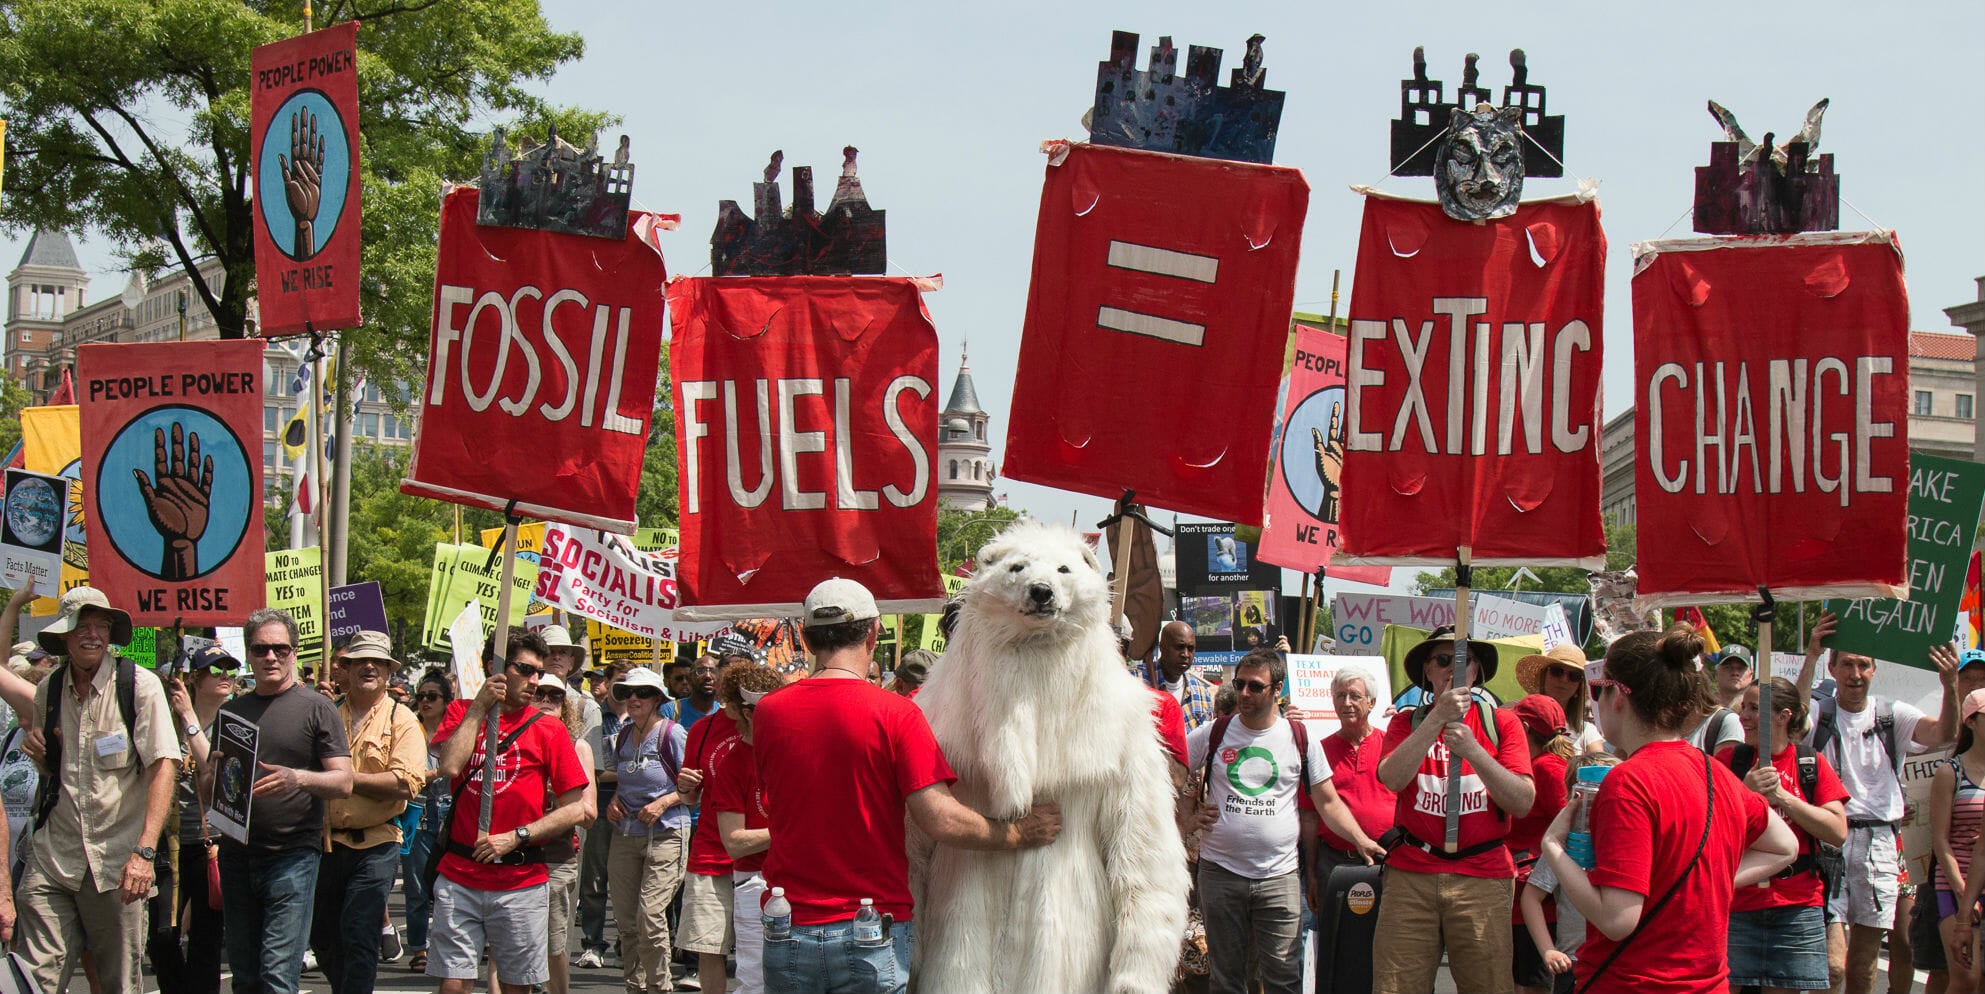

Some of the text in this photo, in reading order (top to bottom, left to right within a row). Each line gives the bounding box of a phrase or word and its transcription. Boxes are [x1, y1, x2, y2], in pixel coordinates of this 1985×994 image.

[258, 49, 352, 92] PEOPLE POWER
[281, 265, 333, 293] WE RISE
[429, 284, 644, 436] FOSSIL
[1294, 349, 1343, 378] PEOPL
[89, 372, 255, 402] PEOPLE POWER
[1346, 296, 1592, 456] EXTINC
[1648, 356, 1895, 507] CHANGE
[680, 374, 933, 514] FUELS
[1910, 468, 1960, 504] AKE
[653, 532, 677, 545] NO TO
[1180, 525, 1200, 533] Don't
[1201, 525, 1220, 533] trade
[1295, 523, 1320, 545] WE
[1908, 515, 1961, 547] RICA
[517, 539, 533, 549] UN
[6, 557, 48, 577] Facts Matter
[275, 554, 299, 568] NO TO
[541, 528, 677, 610] SOCIALIS
[265, 565, 321, 583] MATE CHANGE!
[495, 571, 531, 590] CNGE!
[949, 579, 961, 591] NO
[137, 587, 229, 612] WE RISE
[275, 585, 305, 601] YES TO
[475, 581, 497, 599] YES
[571, 578, 640, 618] Party for
[330, 607, 346, 620] nd
[575, 597, 655, 635] Socialism
[661, 628, 672, 640] &
[678, 626, 735, 643] Libera
[1340, 596, 1393, 623] WE
[1844, 598, 1938, 635] AGAIN
[331, 624, 361, 637] ason
[1477, 608, 1543, 634] NO MORE
[1339, 624, 1373, 645] GO
[1295, 660, 1322, 669] TEXT
[1296, 670, 1337, 679] CLIMAT
[1297, 678, 1311, 687] TO
[1225, 804, 1275, 817] the Earth
[1226, 794, 1276, 807] Friends of
[1421, 790, 1482, 815] GROND
